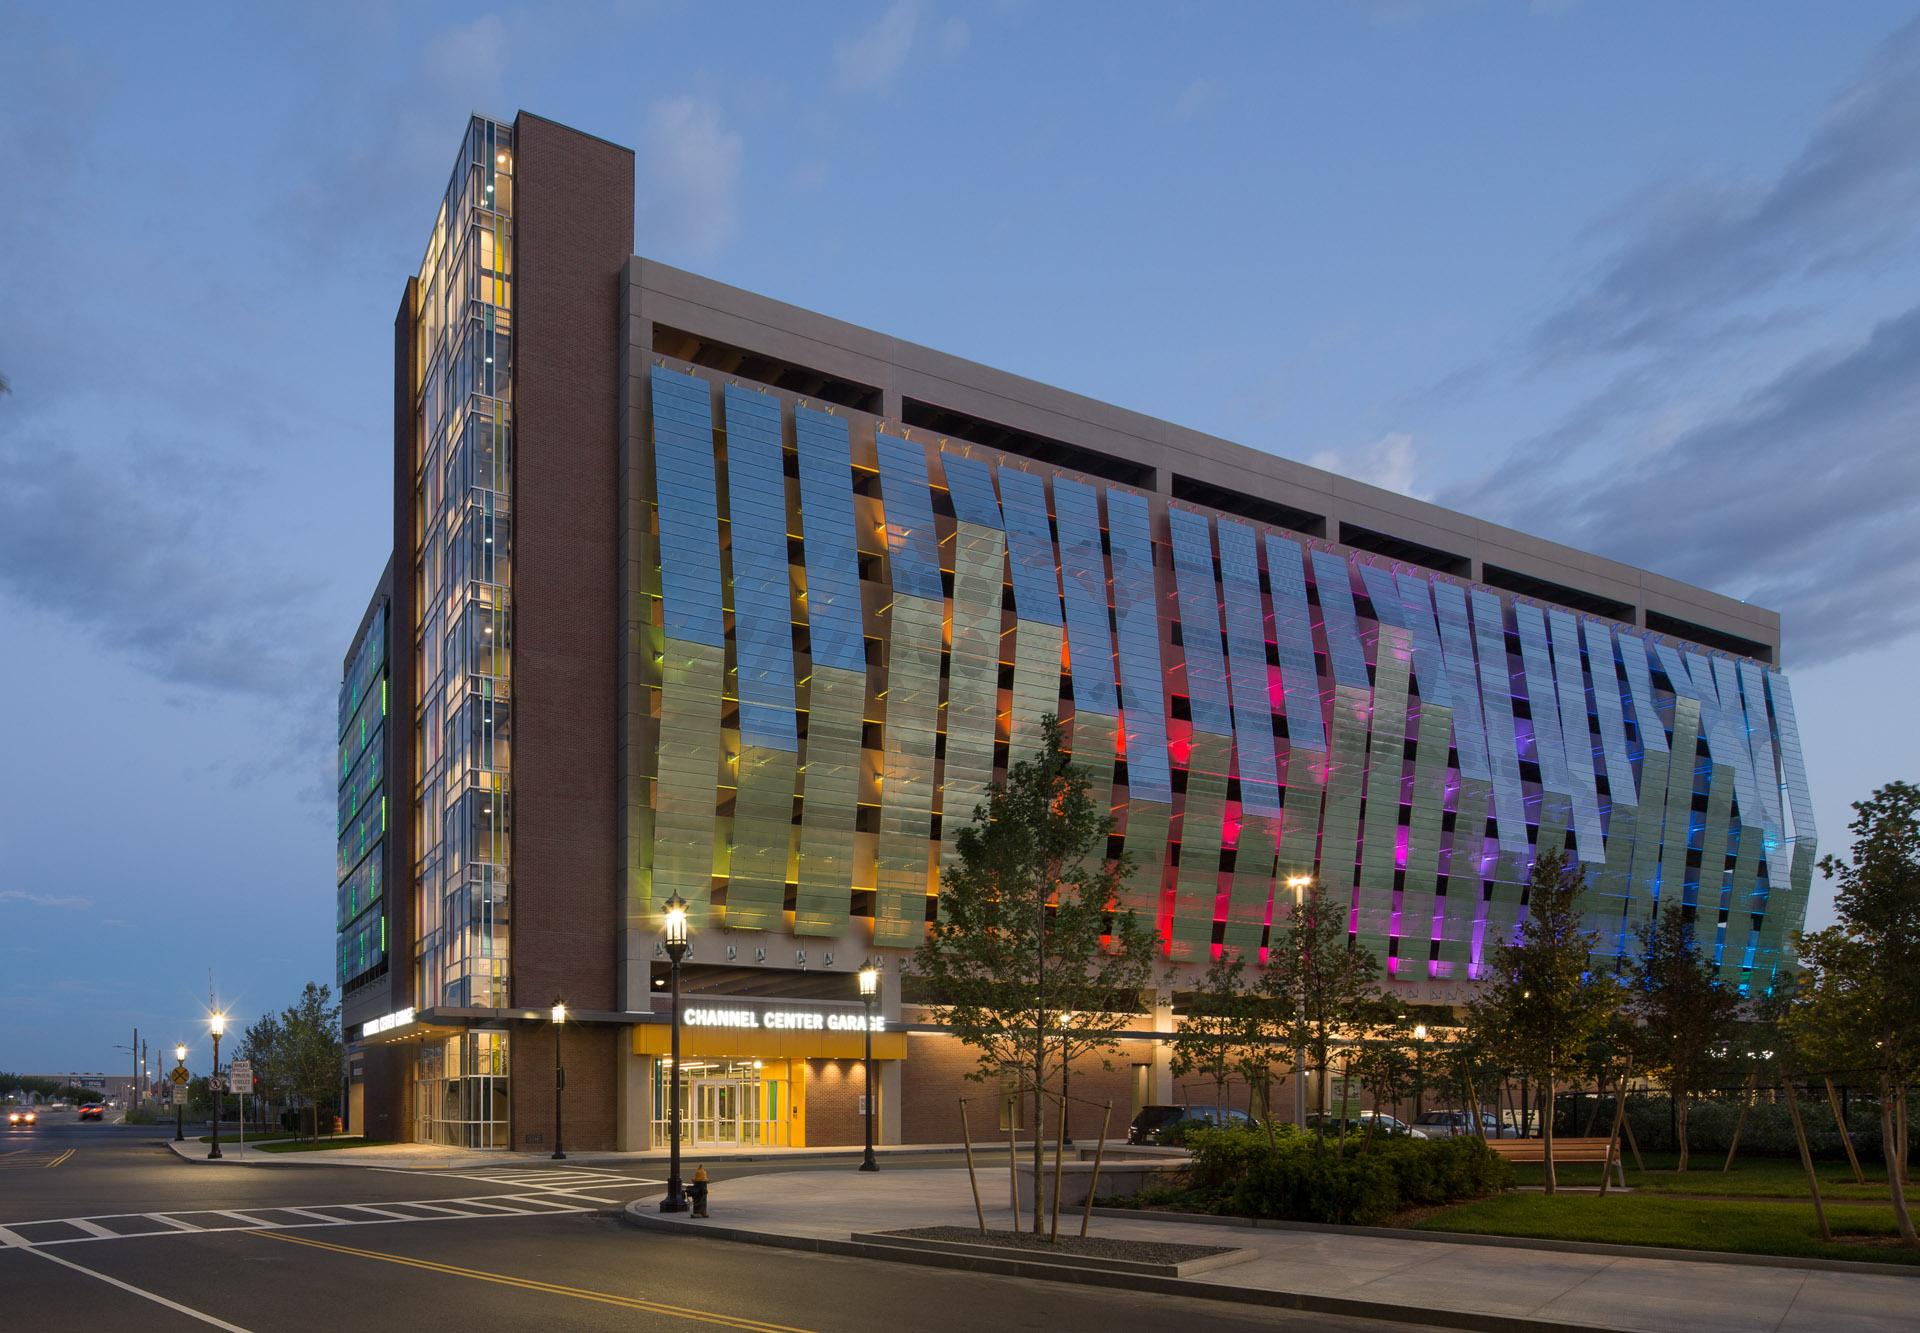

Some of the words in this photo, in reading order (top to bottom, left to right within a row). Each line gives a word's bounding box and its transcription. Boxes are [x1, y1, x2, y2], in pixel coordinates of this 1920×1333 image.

[684, 1008, 759, 1028] CHANNEL
[763, 1011, 824, 1030] CENTER
[827, 1014, 885, 1032] GARAGE
